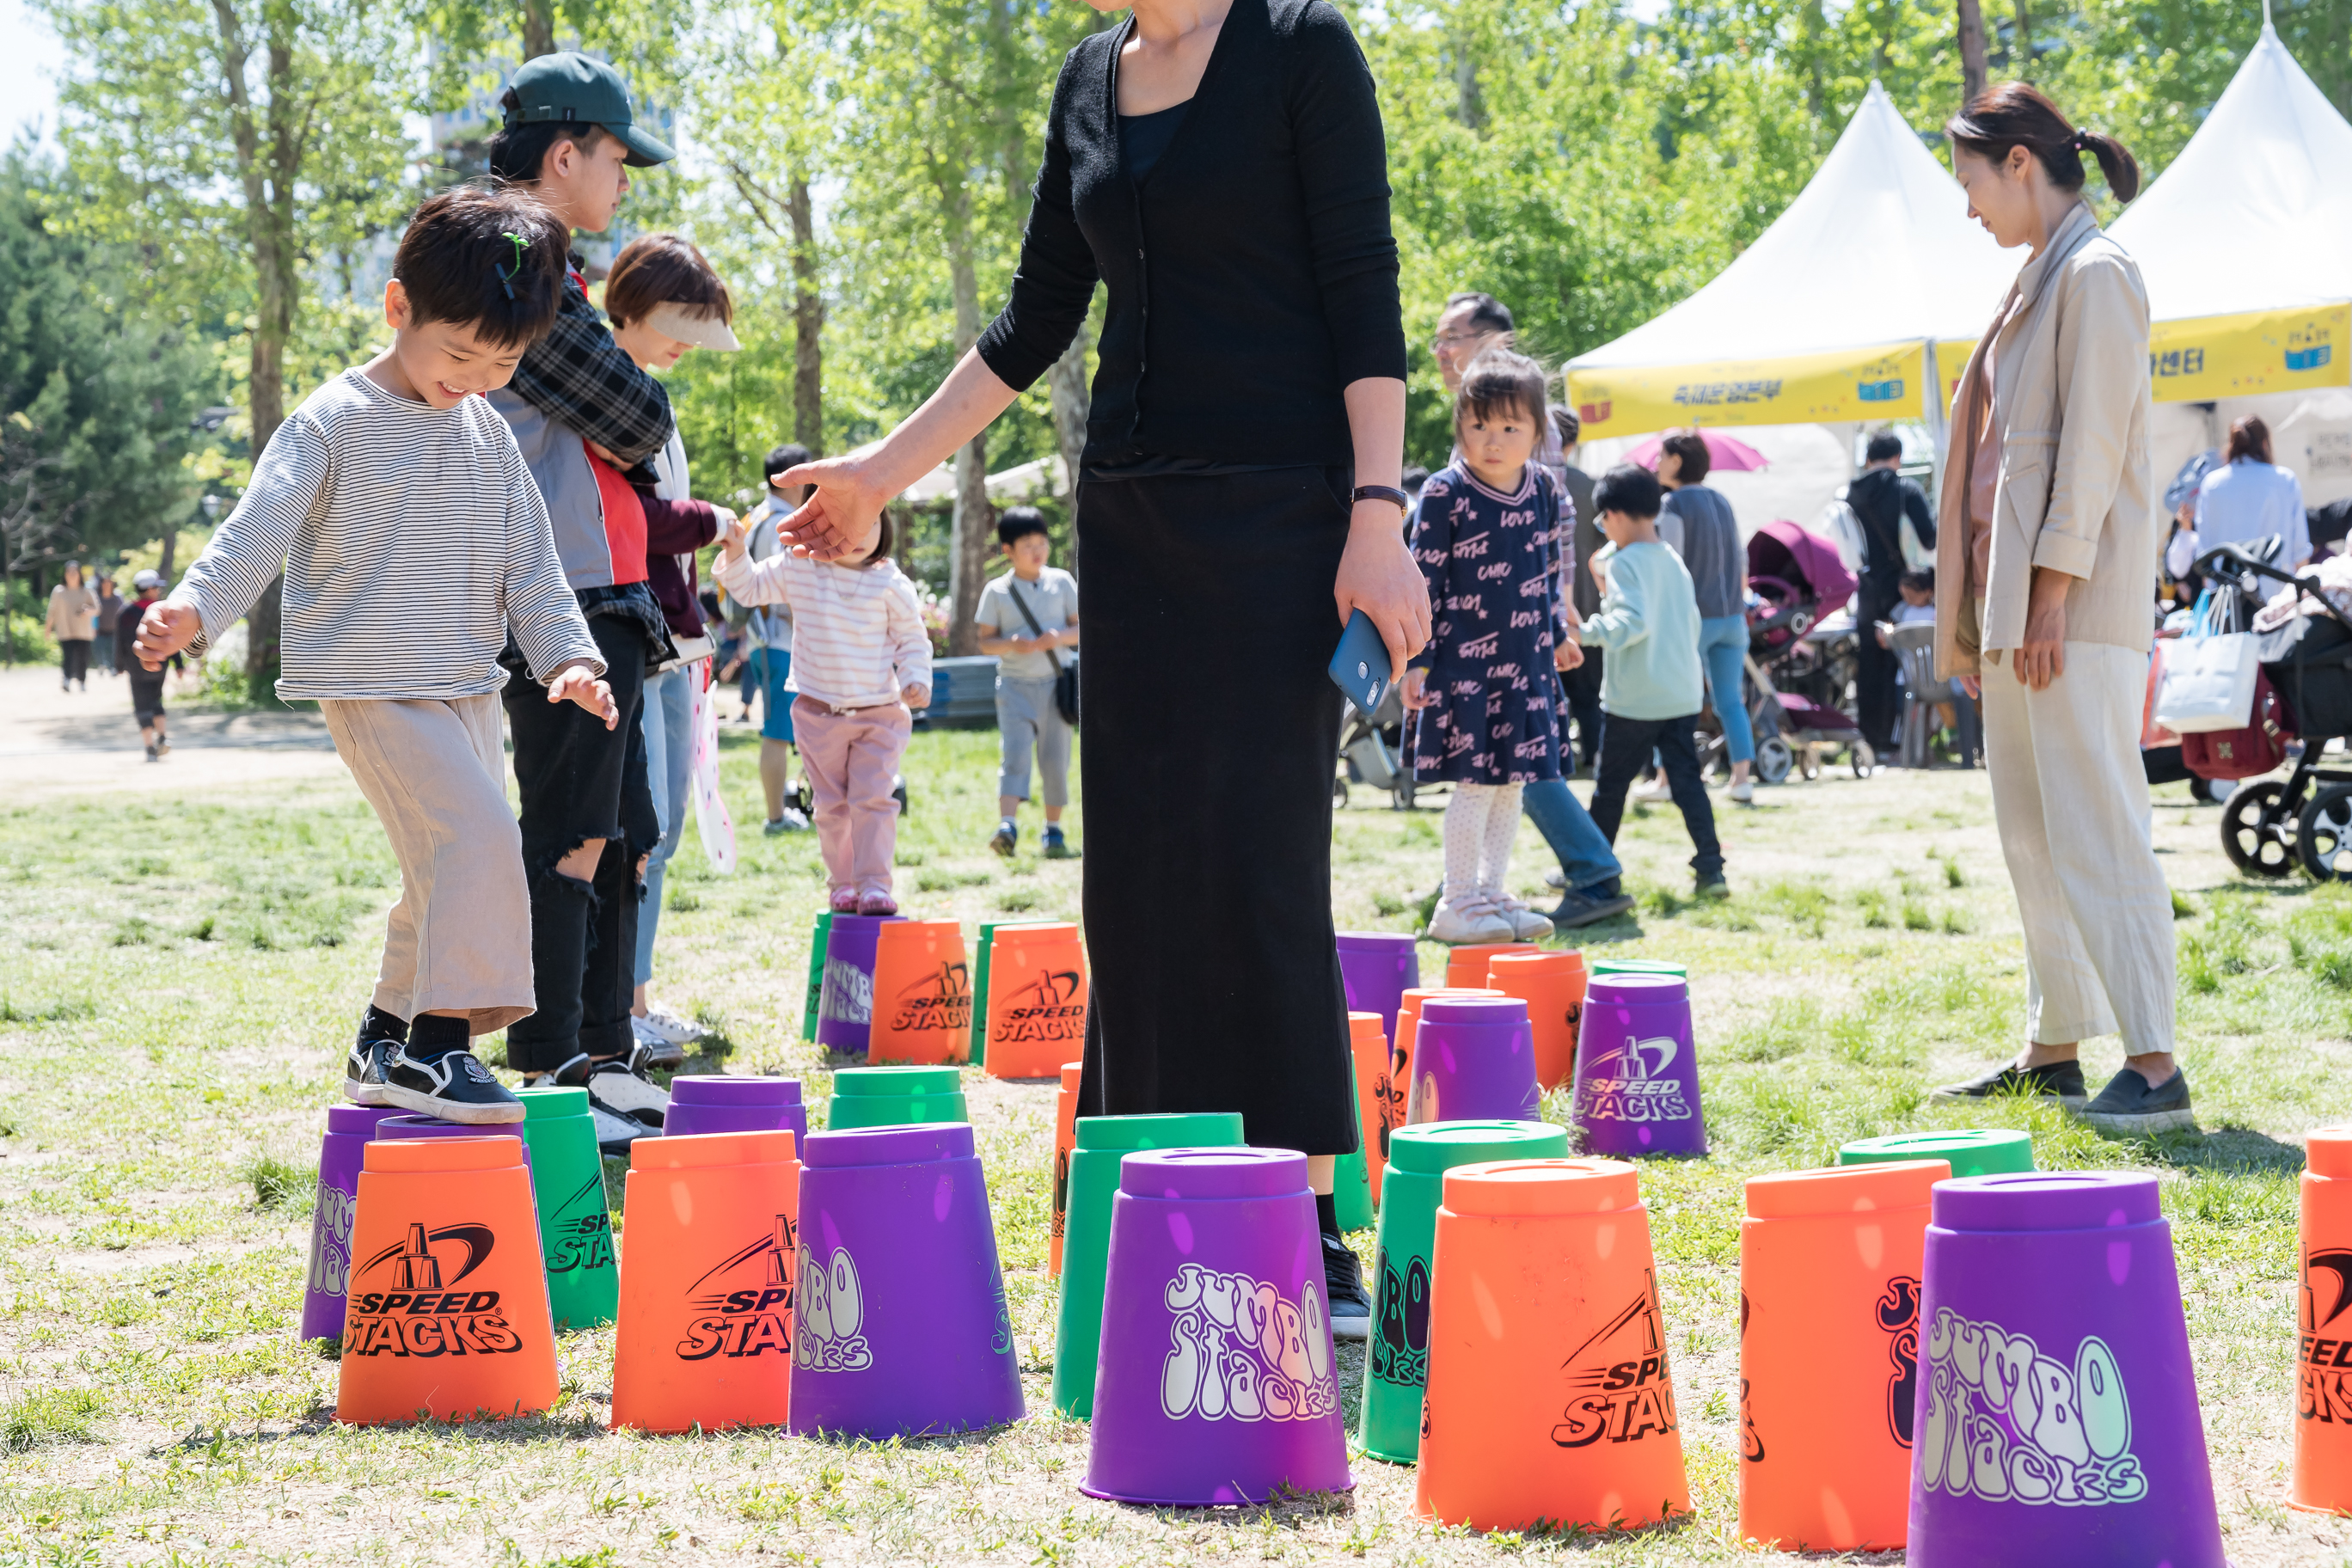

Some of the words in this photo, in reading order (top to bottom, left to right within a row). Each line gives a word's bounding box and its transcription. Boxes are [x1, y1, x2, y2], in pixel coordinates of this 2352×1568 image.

[1500, 510, 1536, 528] LOVE
[1477, 561, 1512, 581] CHIC
[1510, 609, 1542, 629] LOVE
[891, 1008, 970, 1031] STACK
[1011, 1006, 1084, 1020] SPEED
[1589, 1078, 1681, 1095] SPEED
[358, 1291, 500, 1315] SPEED
[343, 1314, 523, 1358] STACKS
[1551, 1381, 1677, 1448] STAC
